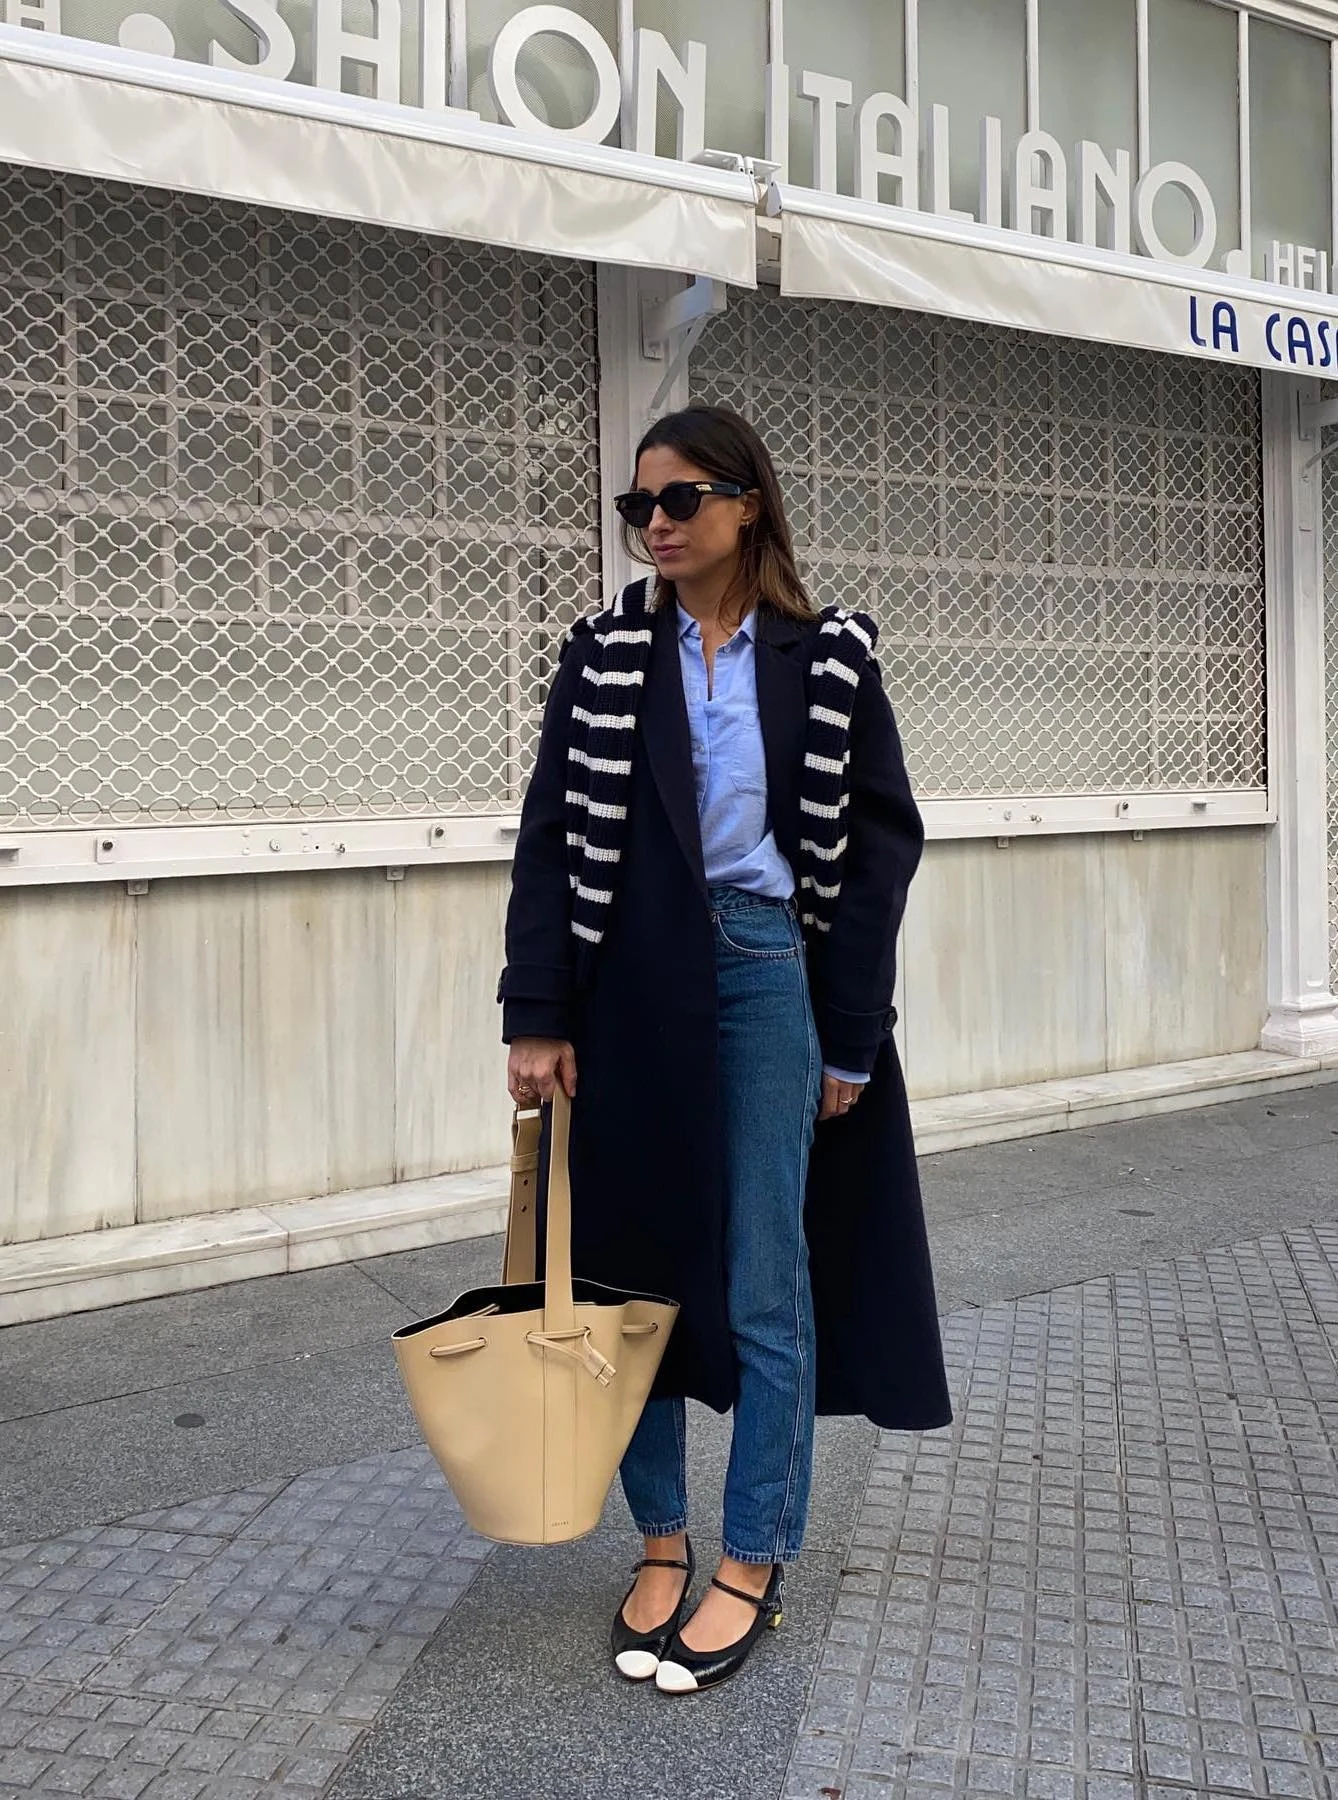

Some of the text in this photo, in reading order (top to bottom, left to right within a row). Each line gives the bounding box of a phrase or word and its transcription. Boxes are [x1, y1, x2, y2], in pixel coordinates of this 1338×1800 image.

[766, 64, 1217, 269] ITALIANO
[1189, 295, 1338, 369] LA CAS
